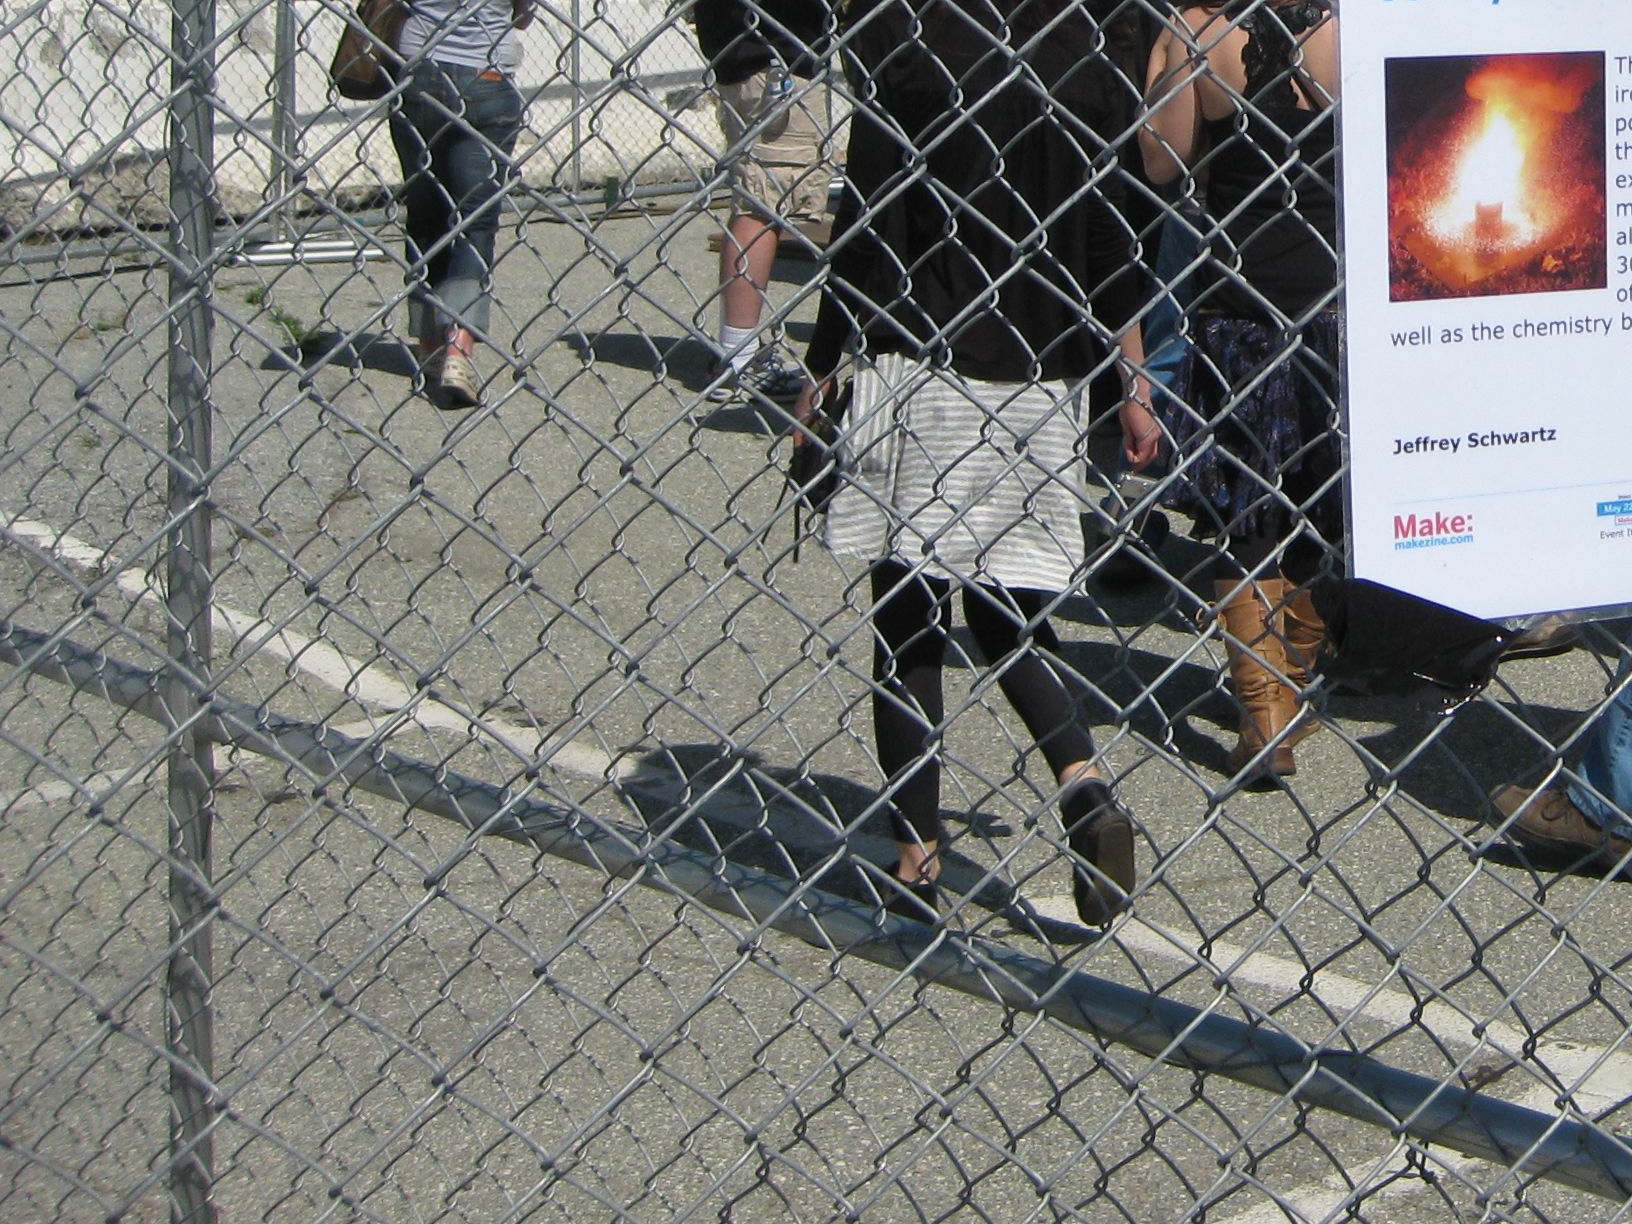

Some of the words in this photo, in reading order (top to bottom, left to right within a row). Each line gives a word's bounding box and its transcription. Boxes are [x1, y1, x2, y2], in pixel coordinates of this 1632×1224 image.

[1391, 326, 1431, 346] well
[1441, 328, 1463, 343] as
[1471, 322, 1504, 341] the
[1513, 316, 1612, 338] chemistry
[1393, 436, 1460, 454] Jeffrey
[1468, 428, 1556, 448] Schwartz
[1394, 511, 1474, 539] Make:
[1600, 530, 1624, 539] Event
[1394, 534, 1474, 551] makezine.com
